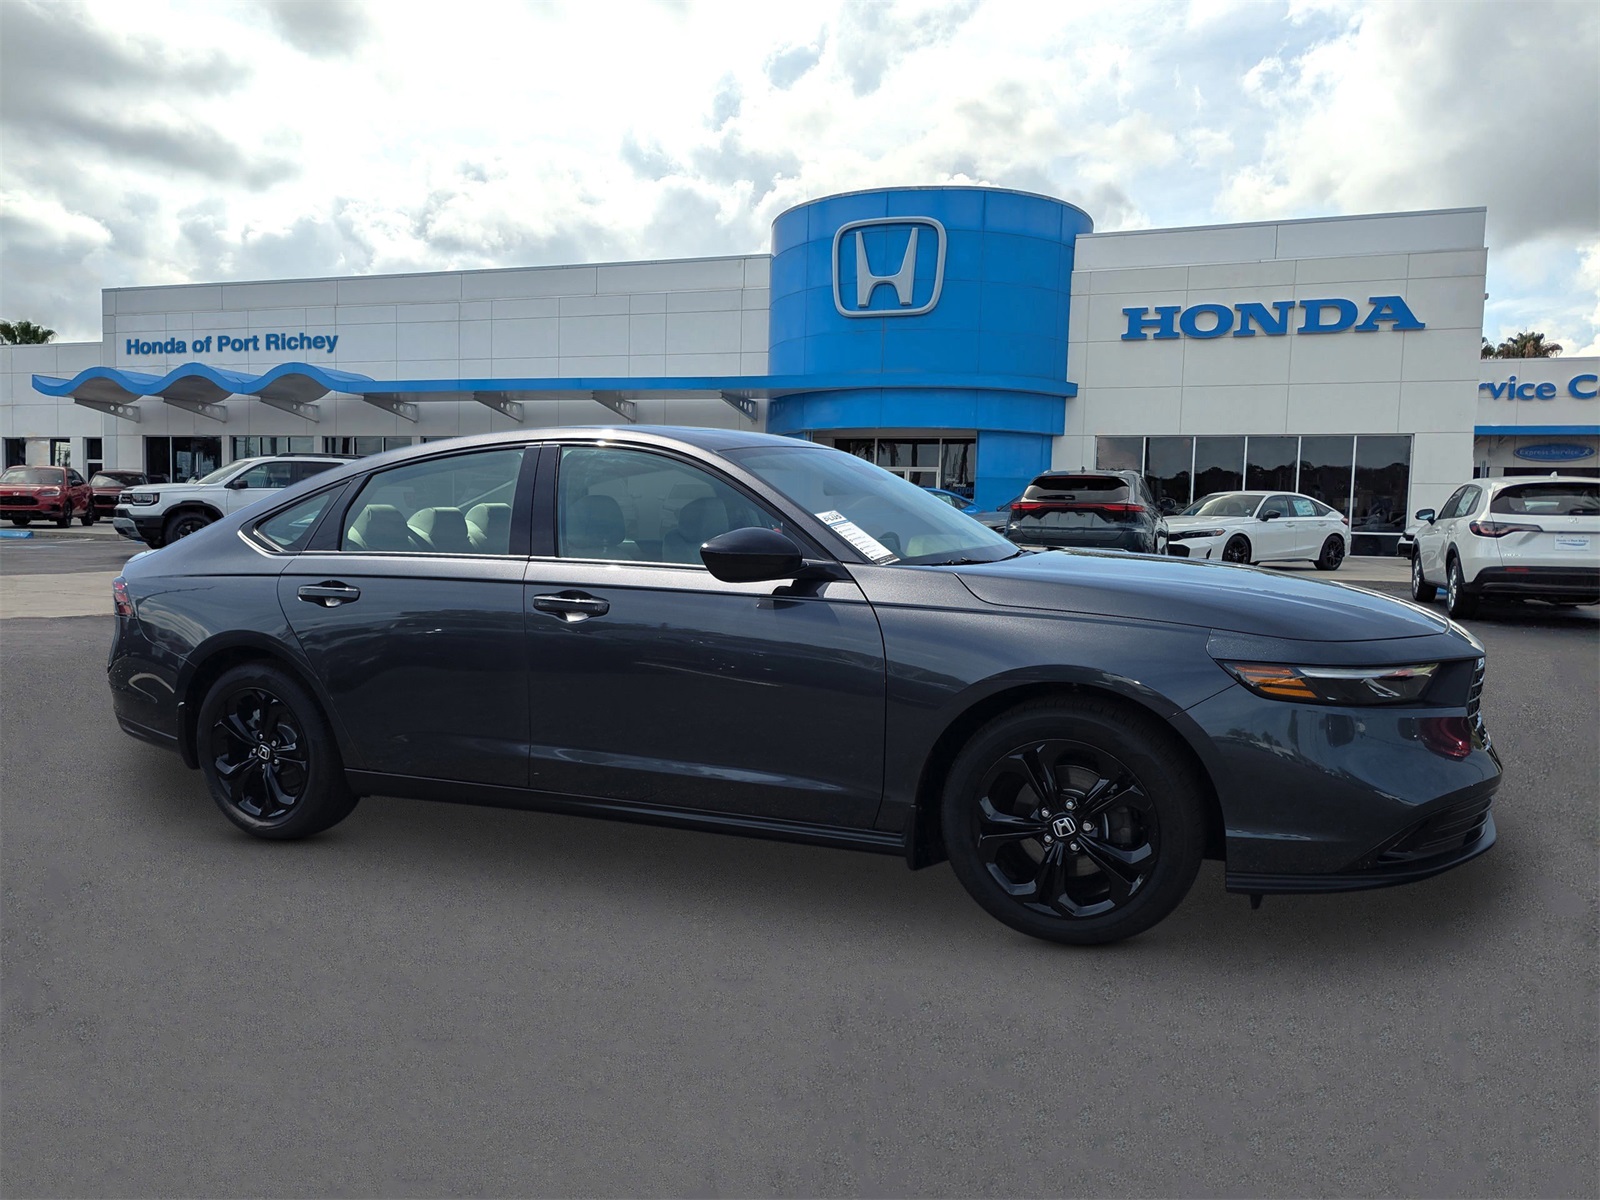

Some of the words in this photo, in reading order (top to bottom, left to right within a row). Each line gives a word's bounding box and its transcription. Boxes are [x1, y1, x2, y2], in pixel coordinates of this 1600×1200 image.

[1121, 296, 1426, 341] HONDA
[126, 337, 187, 355] Honda
[192, 336, 212, 353] of
[217, 335, 260, 352] Port
[265, 332, 339, 354] Richey
[1567, 374, 1600, 400] C
